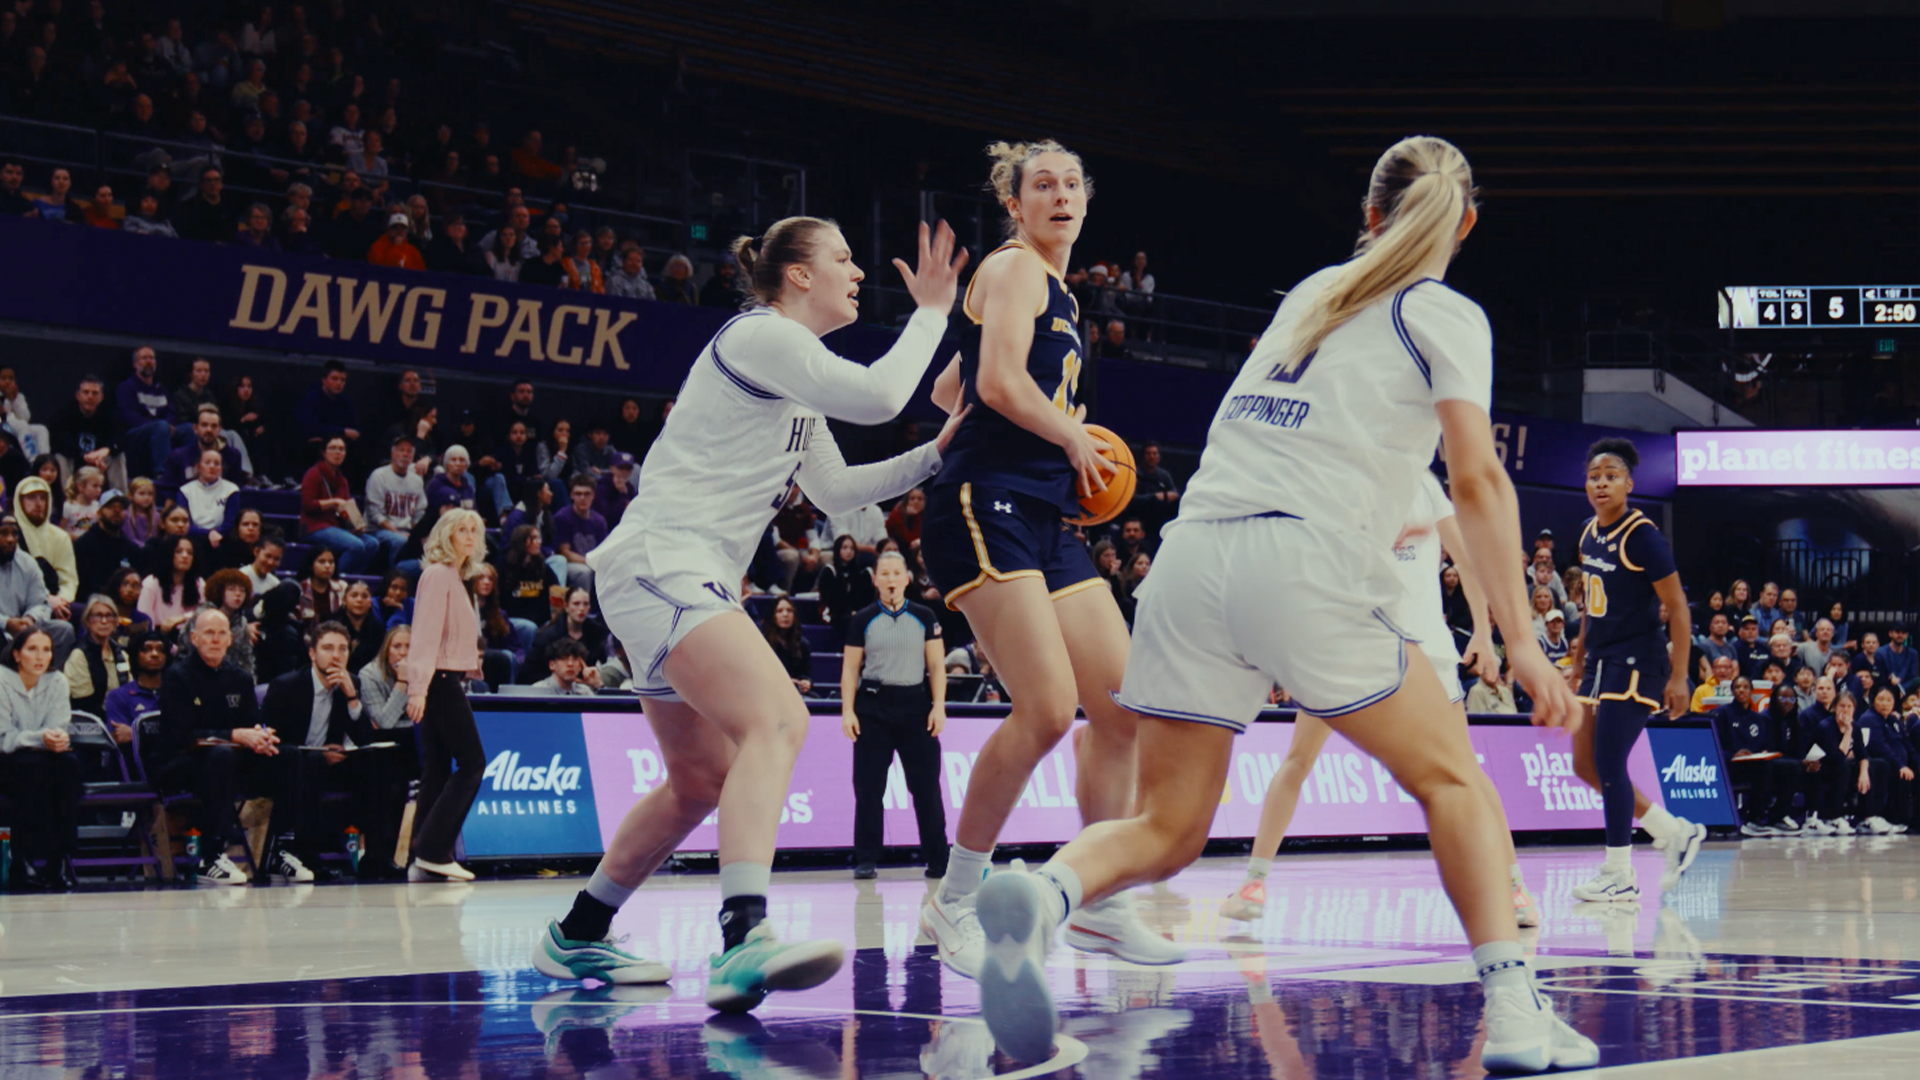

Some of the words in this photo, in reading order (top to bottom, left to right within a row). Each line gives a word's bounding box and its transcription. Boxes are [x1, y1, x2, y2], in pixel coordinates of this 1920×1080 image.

[229, 264, 447, 350] DAWG
[460, 293, 638, 370] PACK
[1763, 303, 1777, 321] 4
[1791, 302, 1803, 320] 3
[1828, 296, 1845, 319] 5
[1874, 303, 1916, 322] 2:50
[1220, 394, 1310, 430] COPPINGER
[1681, 440, 1806, 480] planet
[483, 750, 581, 796] Alaska
[1661, 754, 1717, 786] Alaska
[477, 799, 577, 815] AIRLINES
[1541, 777, 1604, 810] fitne
[1670, 788, 1718, 799] AIRLINES
